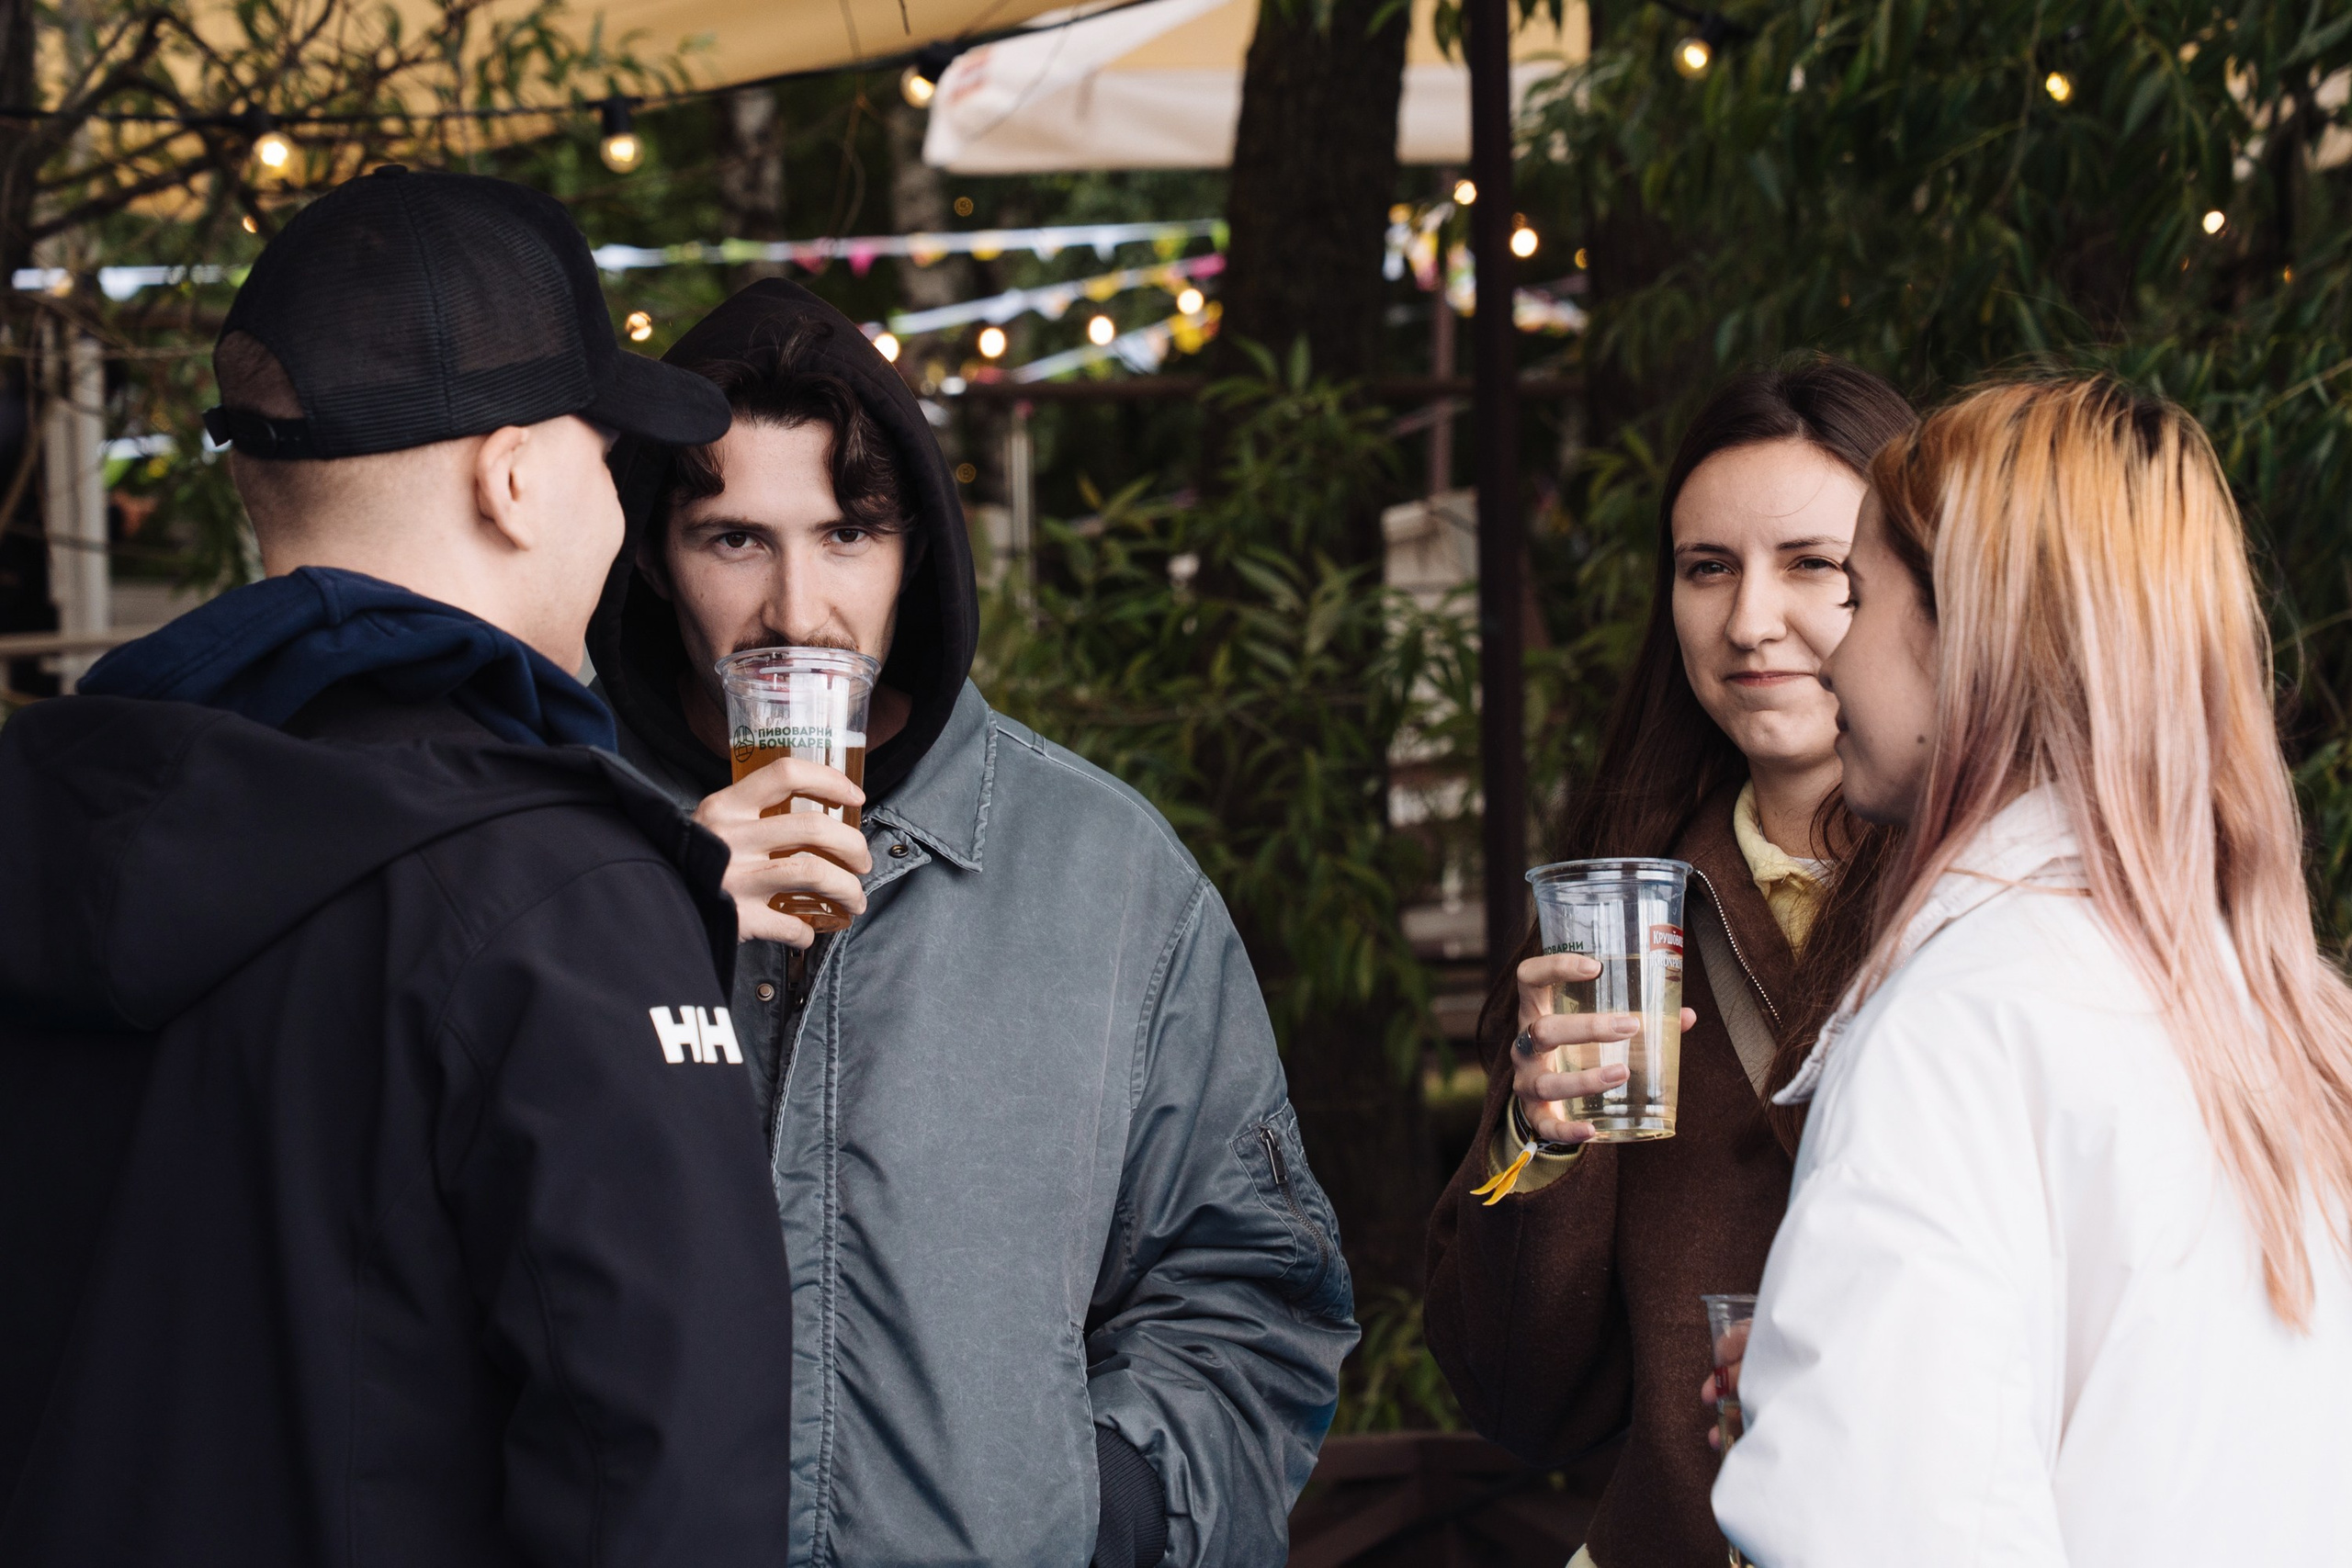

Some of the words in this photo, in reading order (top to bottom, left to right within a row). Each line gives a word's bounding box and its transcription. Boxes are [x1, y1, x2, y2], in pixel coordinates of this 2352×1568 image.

[758, 727, 832, 738] ПИВОВАРНИ
[759, 738, 832, 750] БОЧКАРЕВ
[649, 1005, 743, 1064] HH
